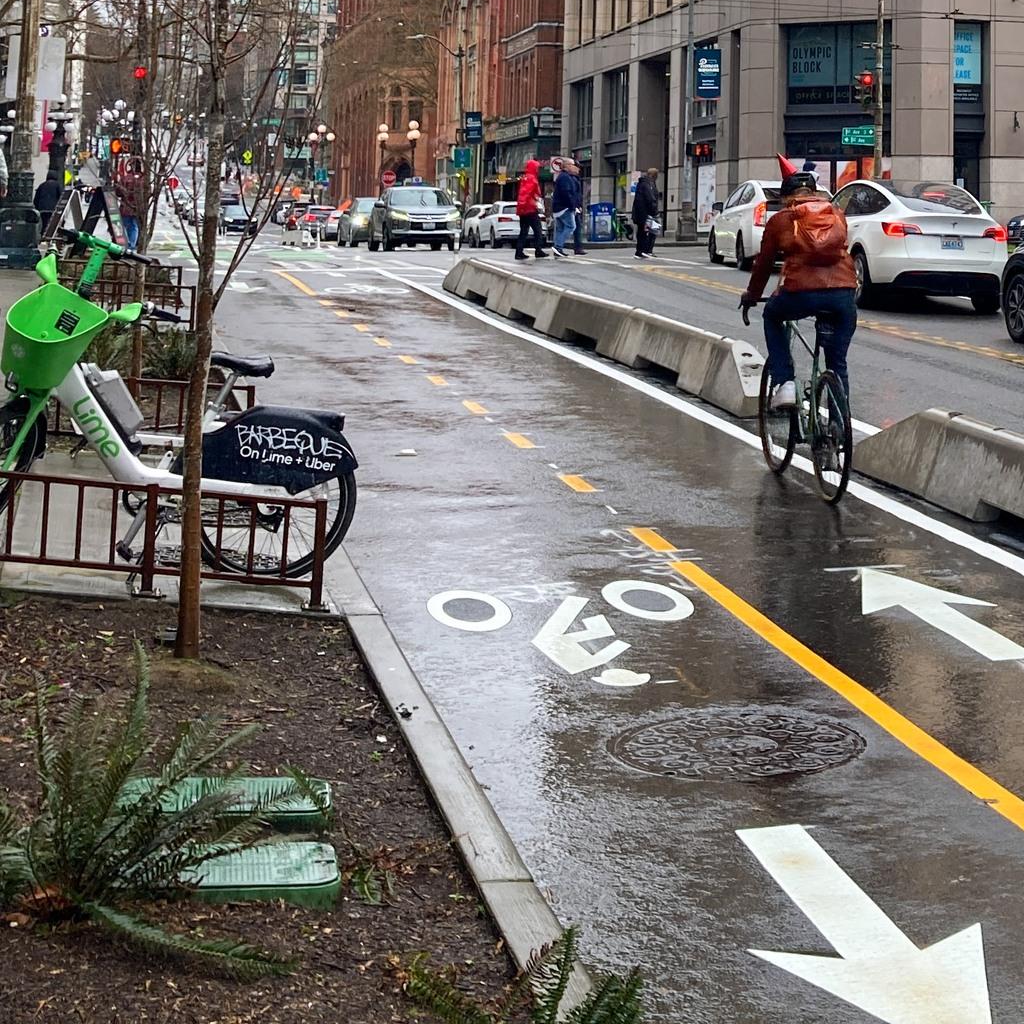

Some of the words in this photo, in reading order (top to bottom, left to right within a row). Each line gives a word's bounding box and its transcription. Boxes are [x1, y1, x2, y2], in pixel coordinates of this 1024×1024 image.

[792, 46, 832, 60] OLYMPIC
[792, 61, 822, 74] BLOCK
[72, 395, 120, 458] Lime
[234, 424, 343, 460] BARBEQUE
[240, 446, 260, 459] On
[261, 449, 293, 465] Lime
[305, 456, 336, 472] Uber
